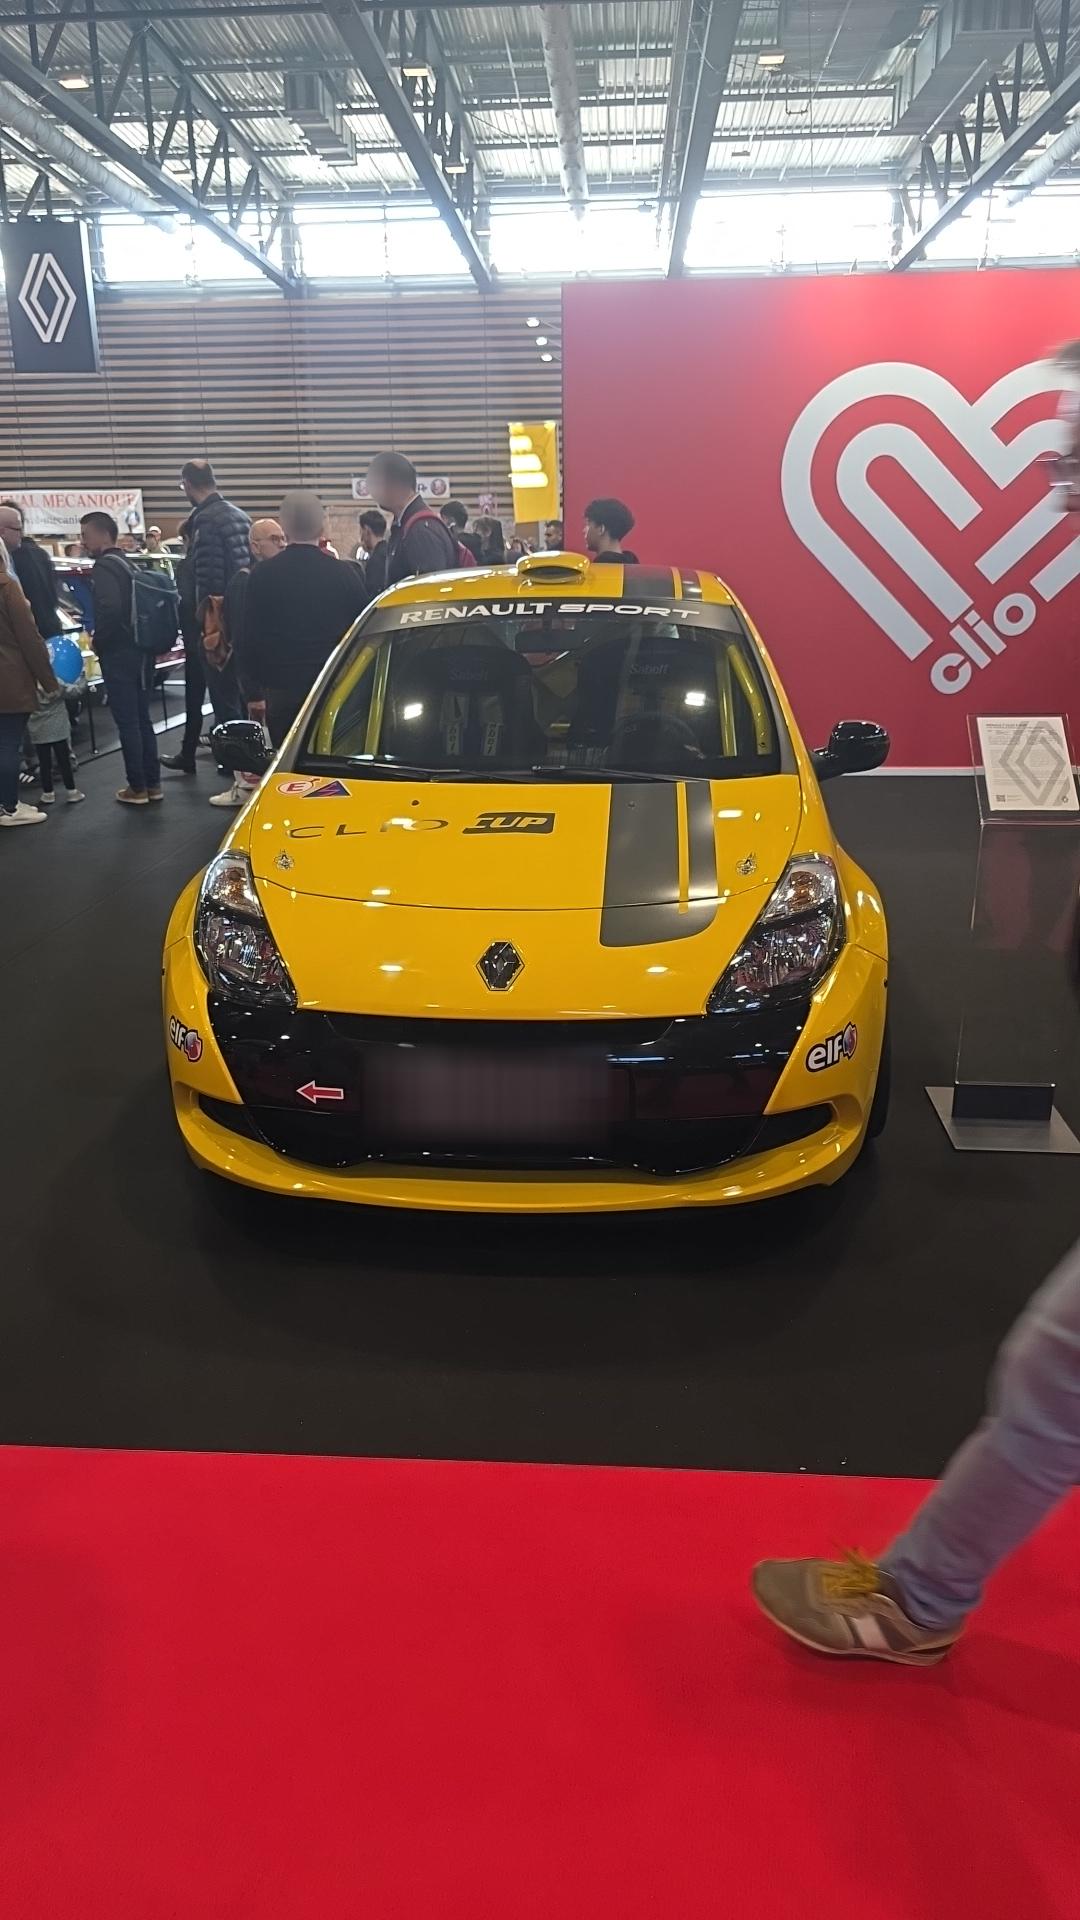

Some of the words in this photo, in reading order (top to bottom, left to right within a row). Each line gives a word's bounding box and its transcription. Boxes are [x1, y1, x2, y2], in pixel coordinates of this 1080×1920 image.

[400, 602, 552, 625] RENAULT
[557, 603, 700, 620] SPORT
[930, 593, 1036, 694] clio
[288, 818, 449, 839] CLIO
[466, 815, 548, 830] CUP
[169, 1016, 187, 1049] elf
[807, 1034, 843, 1070] elf
